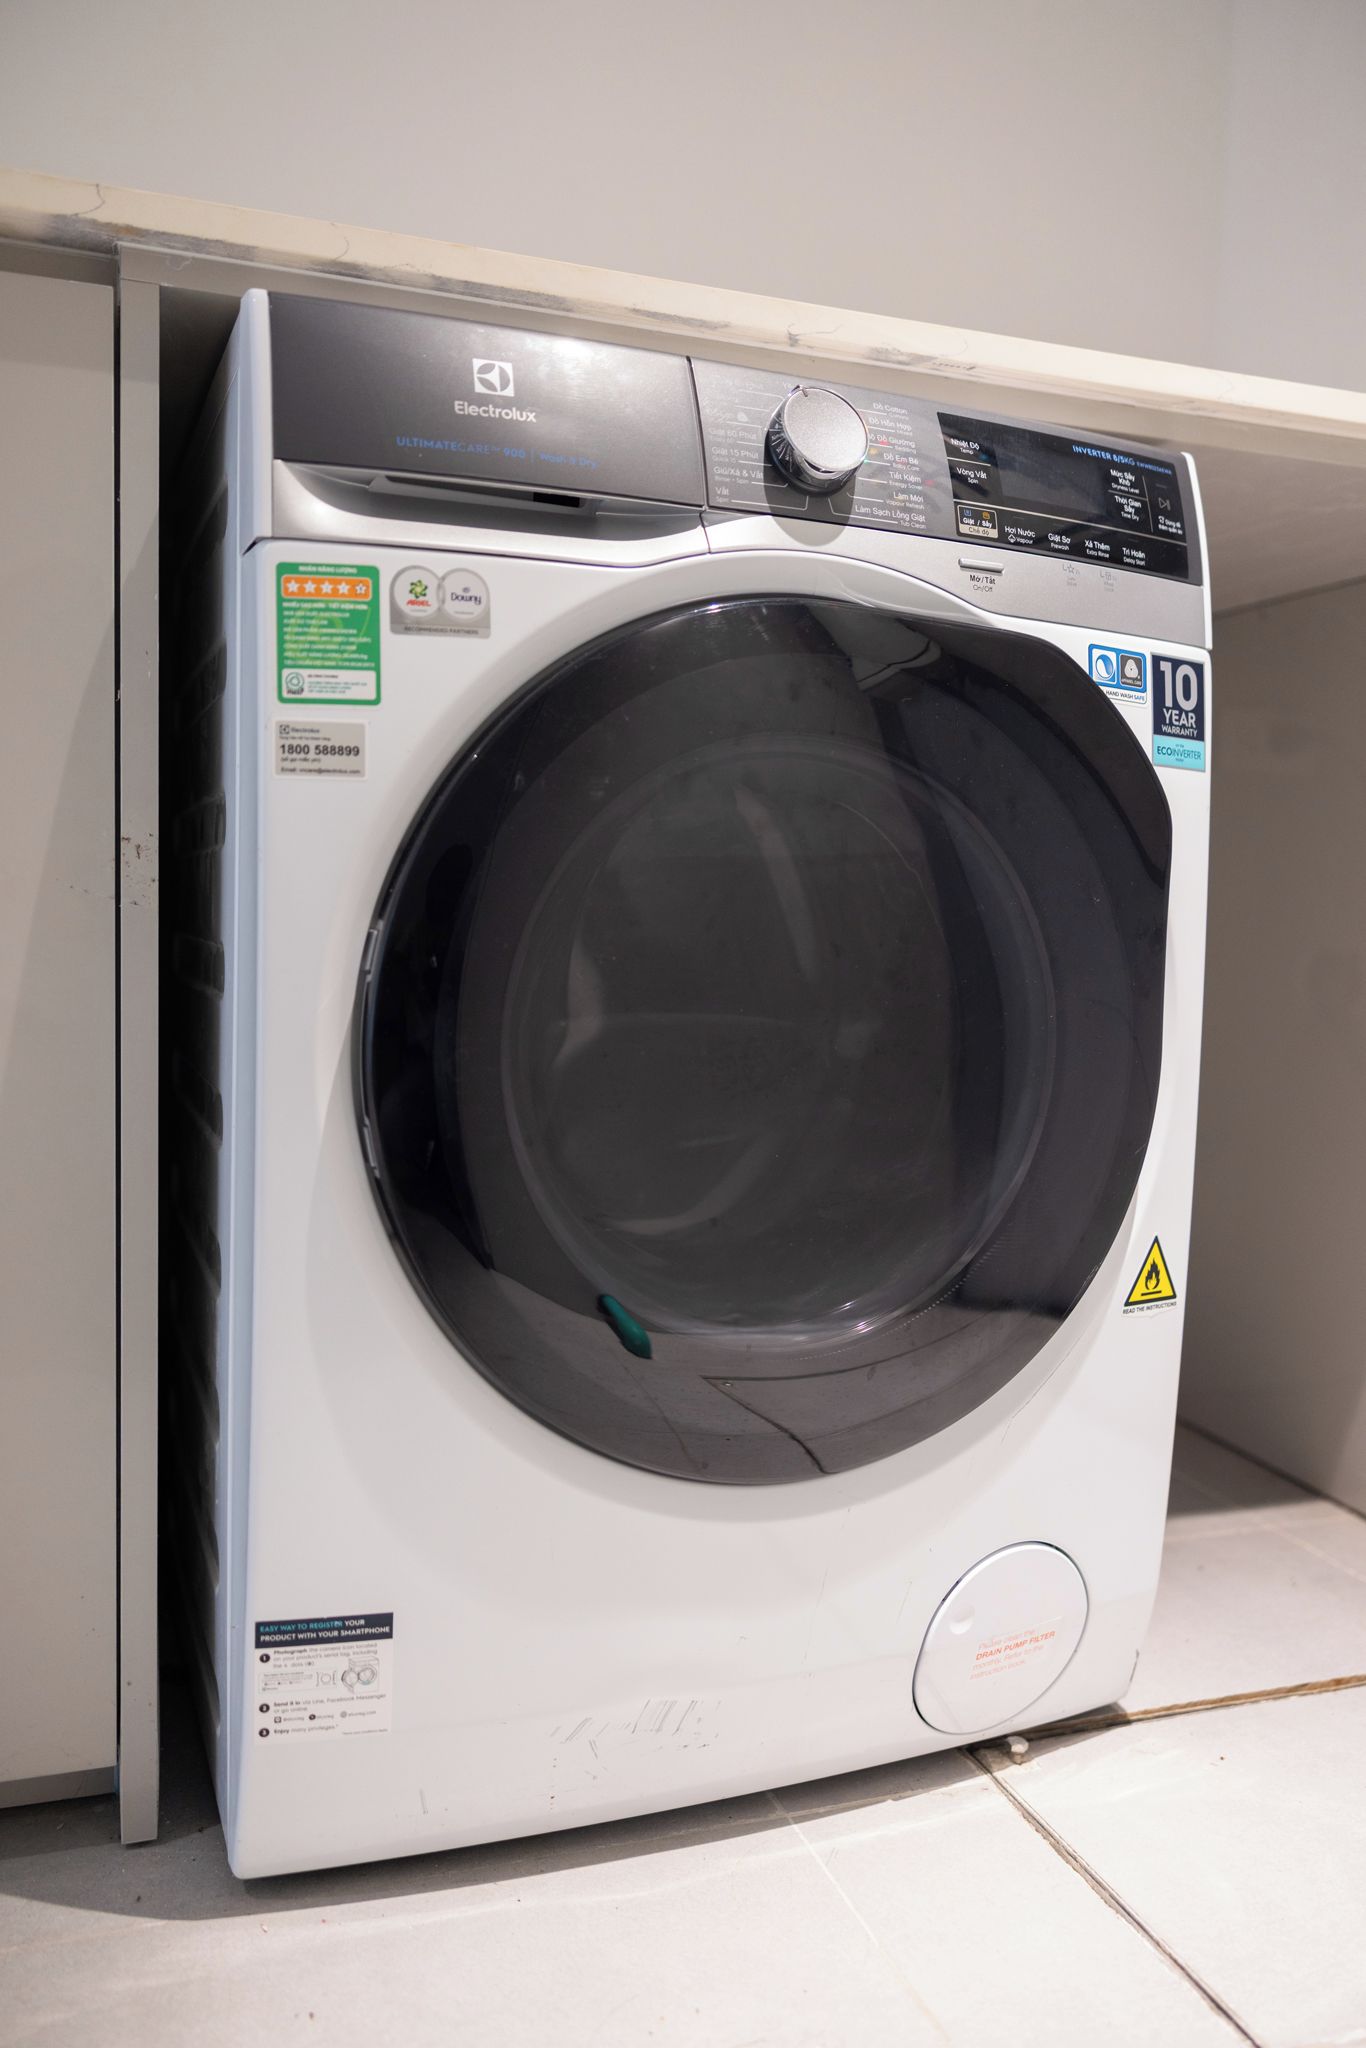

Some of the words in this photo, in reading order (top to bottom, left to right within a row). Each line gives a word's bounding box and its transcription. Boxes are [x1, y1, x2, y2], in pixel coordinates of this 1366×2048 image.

[454, 400, 536, 423] Electrolux
[503, 446, 526, 459] 900
[895, 454, 908, 464] Em
[1072, 445, 1112, 461] INVERTER
[450, 591, 482, 605] Downy
[1160, 660, 1198, 711] 10
[1163, 708, 1196, 728] YEAR
[1161, 724, 1198, 738] WARRANTY
[280, 744, 310, 755] 1800
[314, 744, 360, 757] 588899
[1146, 1301, 1177, 1310] INSTRUCTIONS
[260, 1624, 279, 1633] EASY
[281, 1623, 296, 1631] WAY
[298, 1621, 308, 1630] TO
[310, 1619, 343, 1629] REGISTER
[345, 1618, 365, 1627] YOUR
[260, 1631, 296, 1642] PRODUCT
[298, 1631, 317, 1640] WITH
[318, 1629, 339, 1638] YOUR
[340, 1626, 390, 1637] SMARTPHONE
[976, 1648, 1002, 1660] DRAIN
[1004, 1639, 1028, 1652] PUMP
[1029, 1630, 1056, 1645] FILTER
